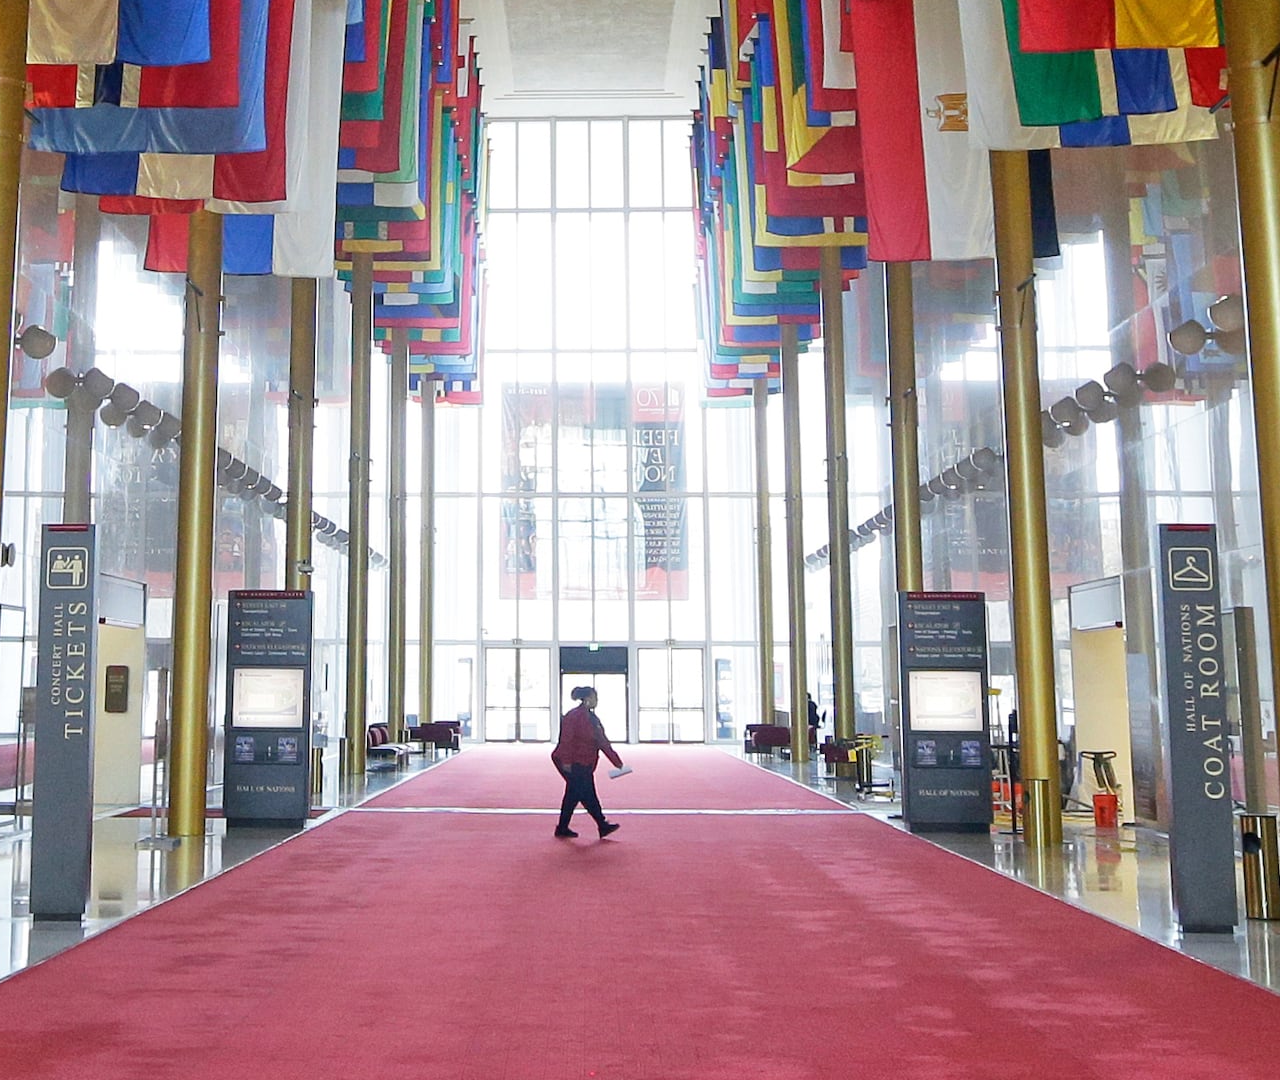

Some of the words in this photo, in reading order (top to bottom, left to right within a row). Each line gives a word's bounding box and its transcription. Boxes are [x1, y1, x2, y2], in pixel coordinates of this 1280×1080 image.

[53, 603, 64, 636] HALL
[1180, 603, 1194, 663] NATIONS
[51, 645, 63, 705] CONCERT
[64, 602, 87, 739] TICKETS
[1195, 604, 1220, 698] ROOM
[1184, 671, 1194, 689] OF
[1186, 695, 1196, 732] HALL
[1200, 714, 1225, 800] COAT
[236, 785, 255, 793] HALL
[266, 785, 296, 793] NATIONS
[918, 789, 937, 797] HALL
[939, 789, 948, 797] OF
[950, 789, 980, 797] NATIONS
